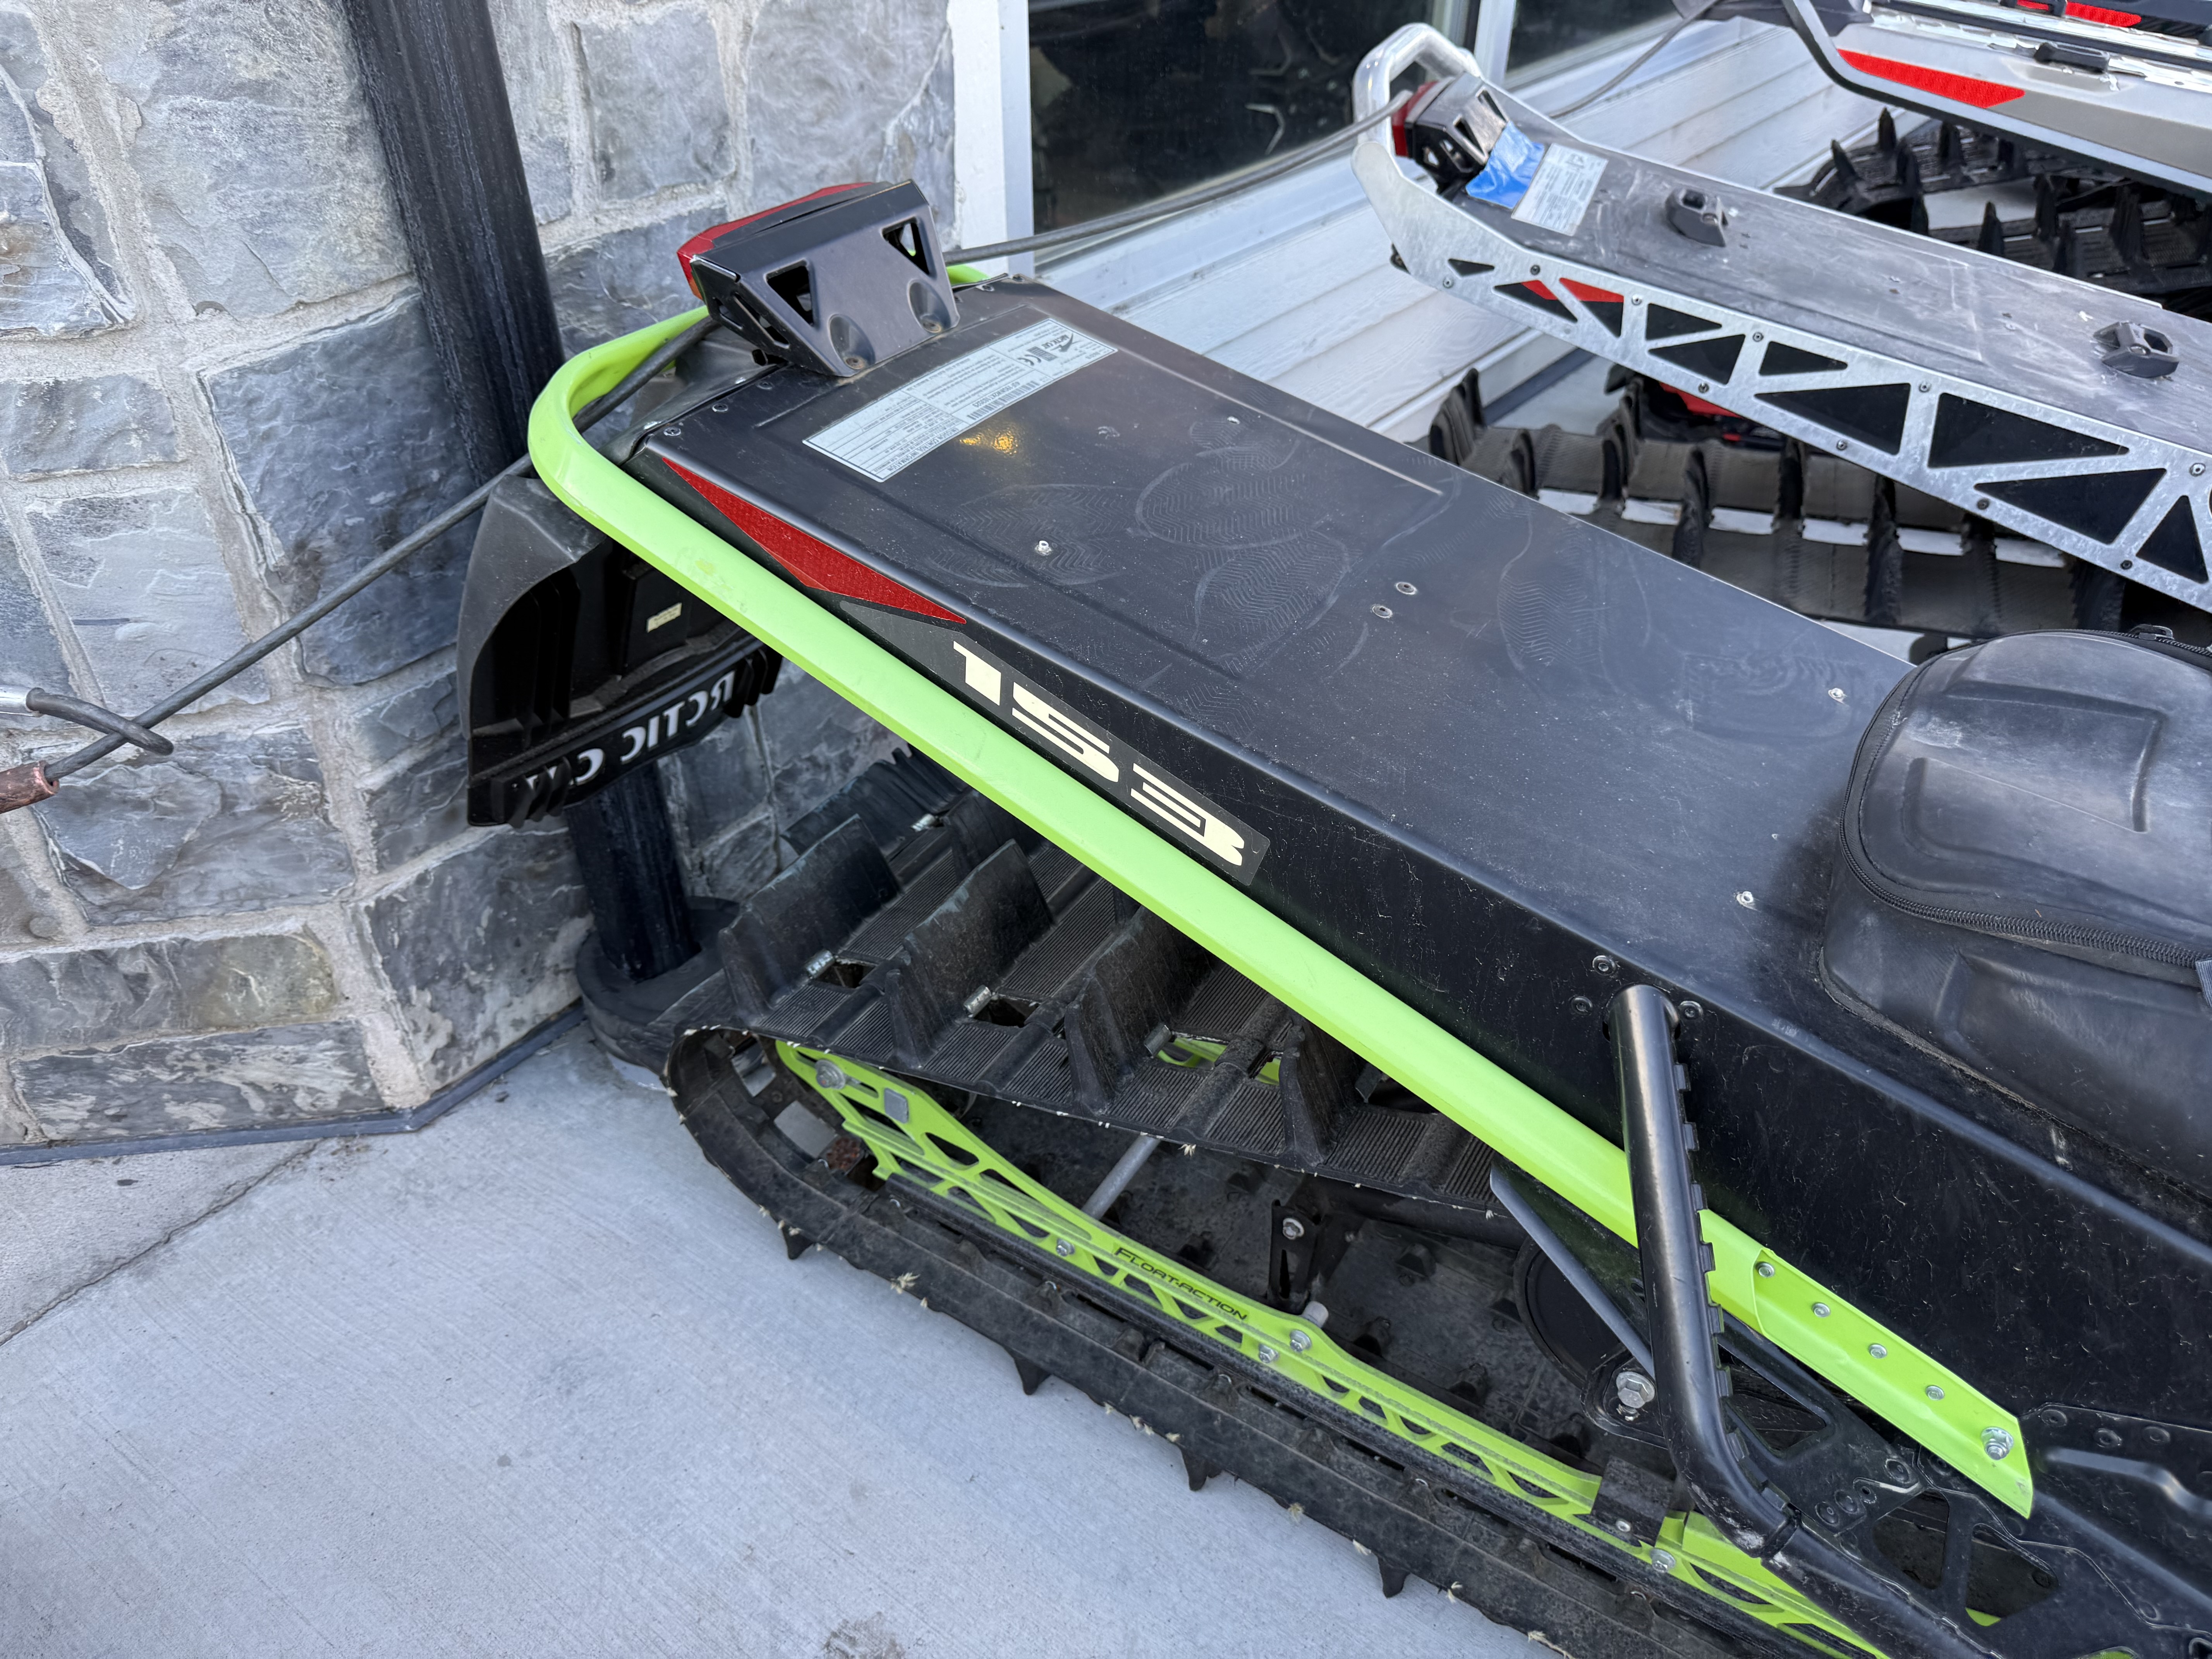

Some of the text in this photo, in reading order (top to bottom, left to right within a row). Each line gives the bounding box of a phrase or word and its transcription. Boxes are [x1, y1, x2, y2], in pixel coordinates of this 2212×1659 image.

[1049, 334, 1070, 345] ARCTIC
[937, 427, 960, 440] EMISSION
[917, 438, 940, 452] CONTROL
[887, 451, 920, 471] INFORMATION
[953, 641, 1244, 866] 153
[1115, 1247, 1247, 1320] FLOAT-ACTION
